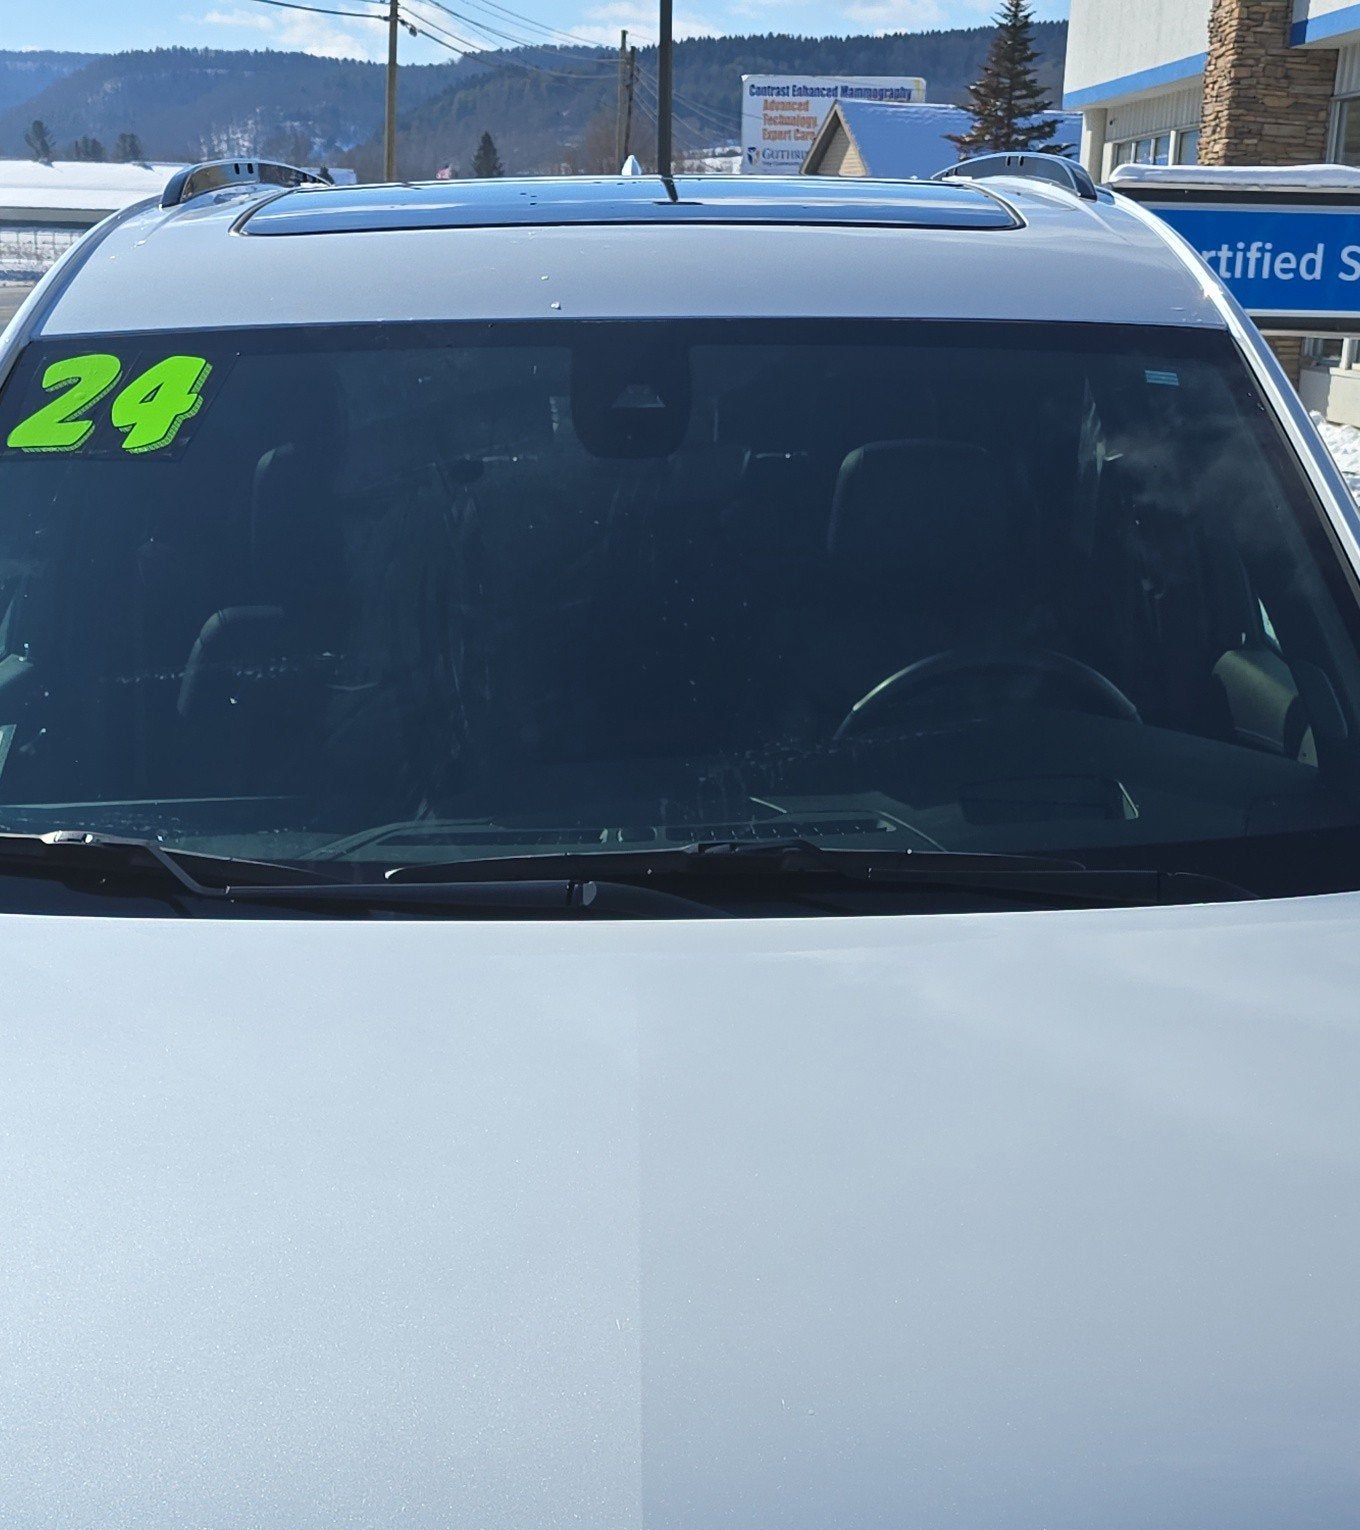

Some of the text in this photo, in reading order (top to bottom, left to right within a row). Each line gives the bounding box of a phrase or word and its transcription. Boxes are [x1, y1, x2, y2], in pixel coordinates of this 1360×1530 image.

[749, 84, 790, 97] Contrast
[792, 84, 838, 97] Enhanced
[1201, 242, 1325, 281] rtified
[7, 354, 213, 454] 24
